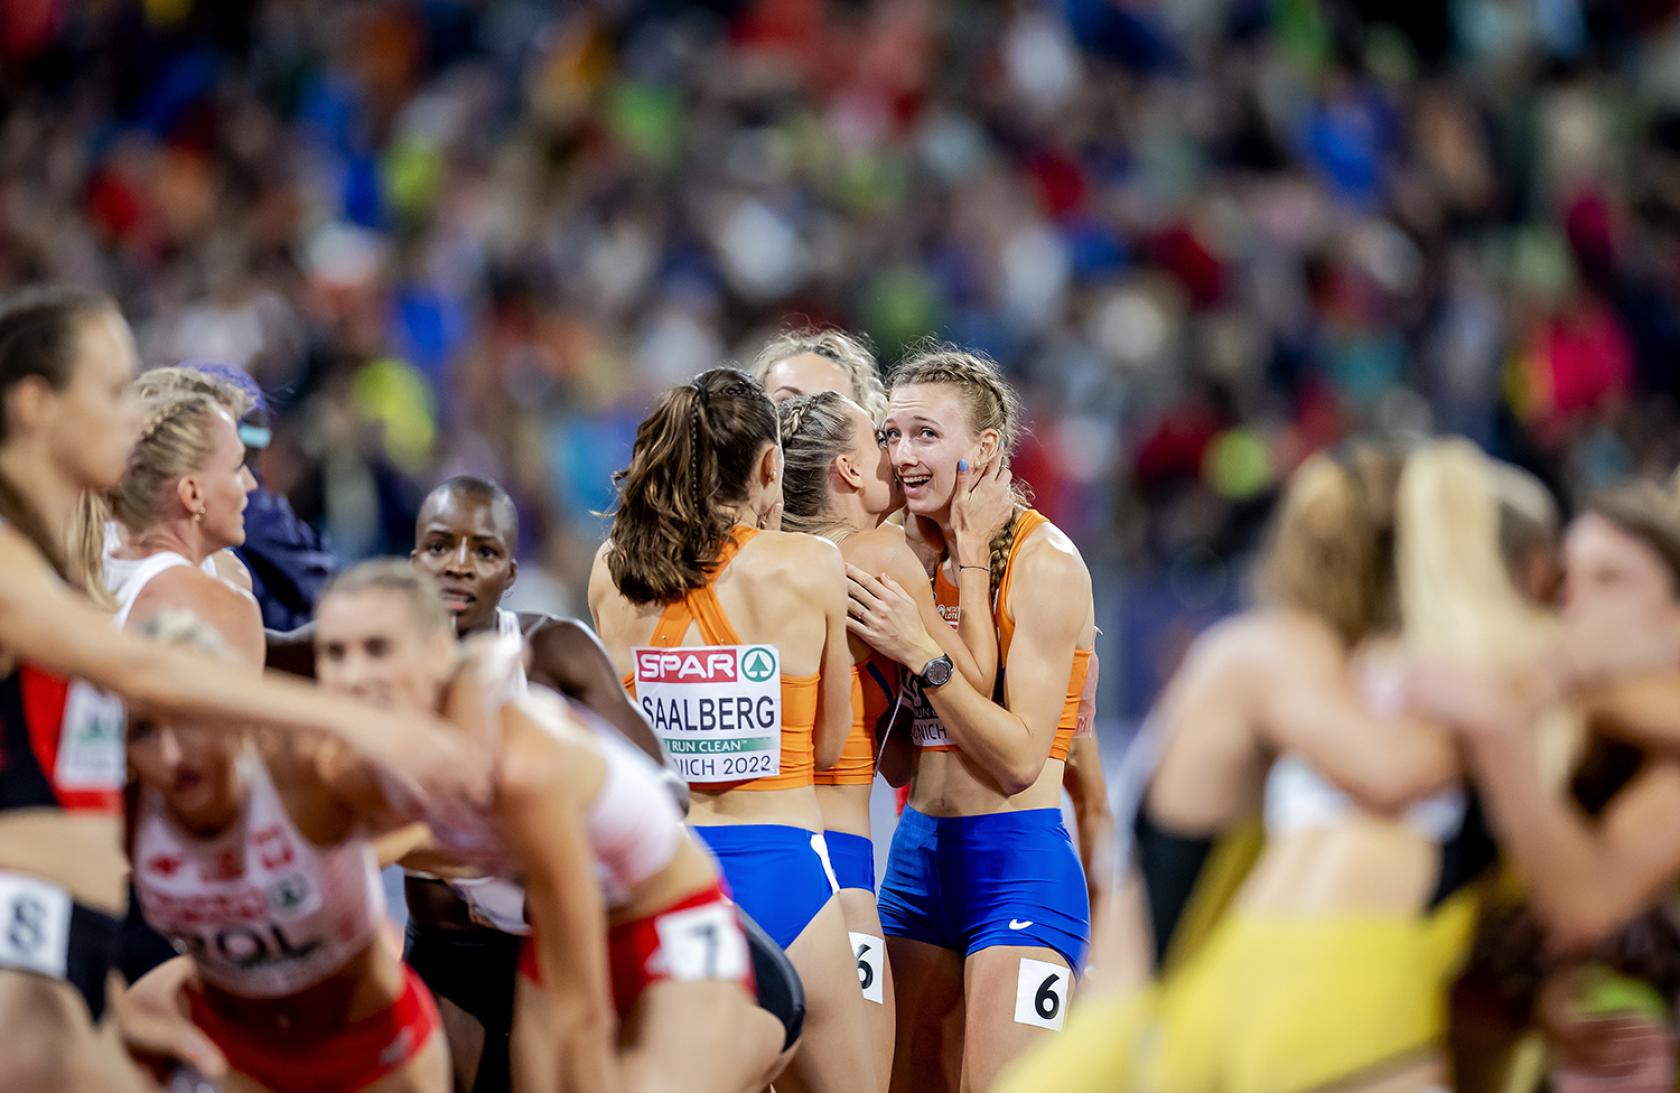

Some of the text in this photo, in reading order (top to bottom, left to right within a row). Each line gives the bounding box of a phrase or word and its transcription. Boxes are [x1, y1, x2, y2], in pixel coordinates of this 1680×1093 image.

[640, 653, 736, 679] SPAR
[642, 695, 775, 731] SAALBERG
[671, 740, 696, 752] RUN
[723, 755, 771, 775] 2022
[686, 921, 720, 979] 7
[856, 943, 873, 990] 6
[1034, 973, 1061, 1020] 6
